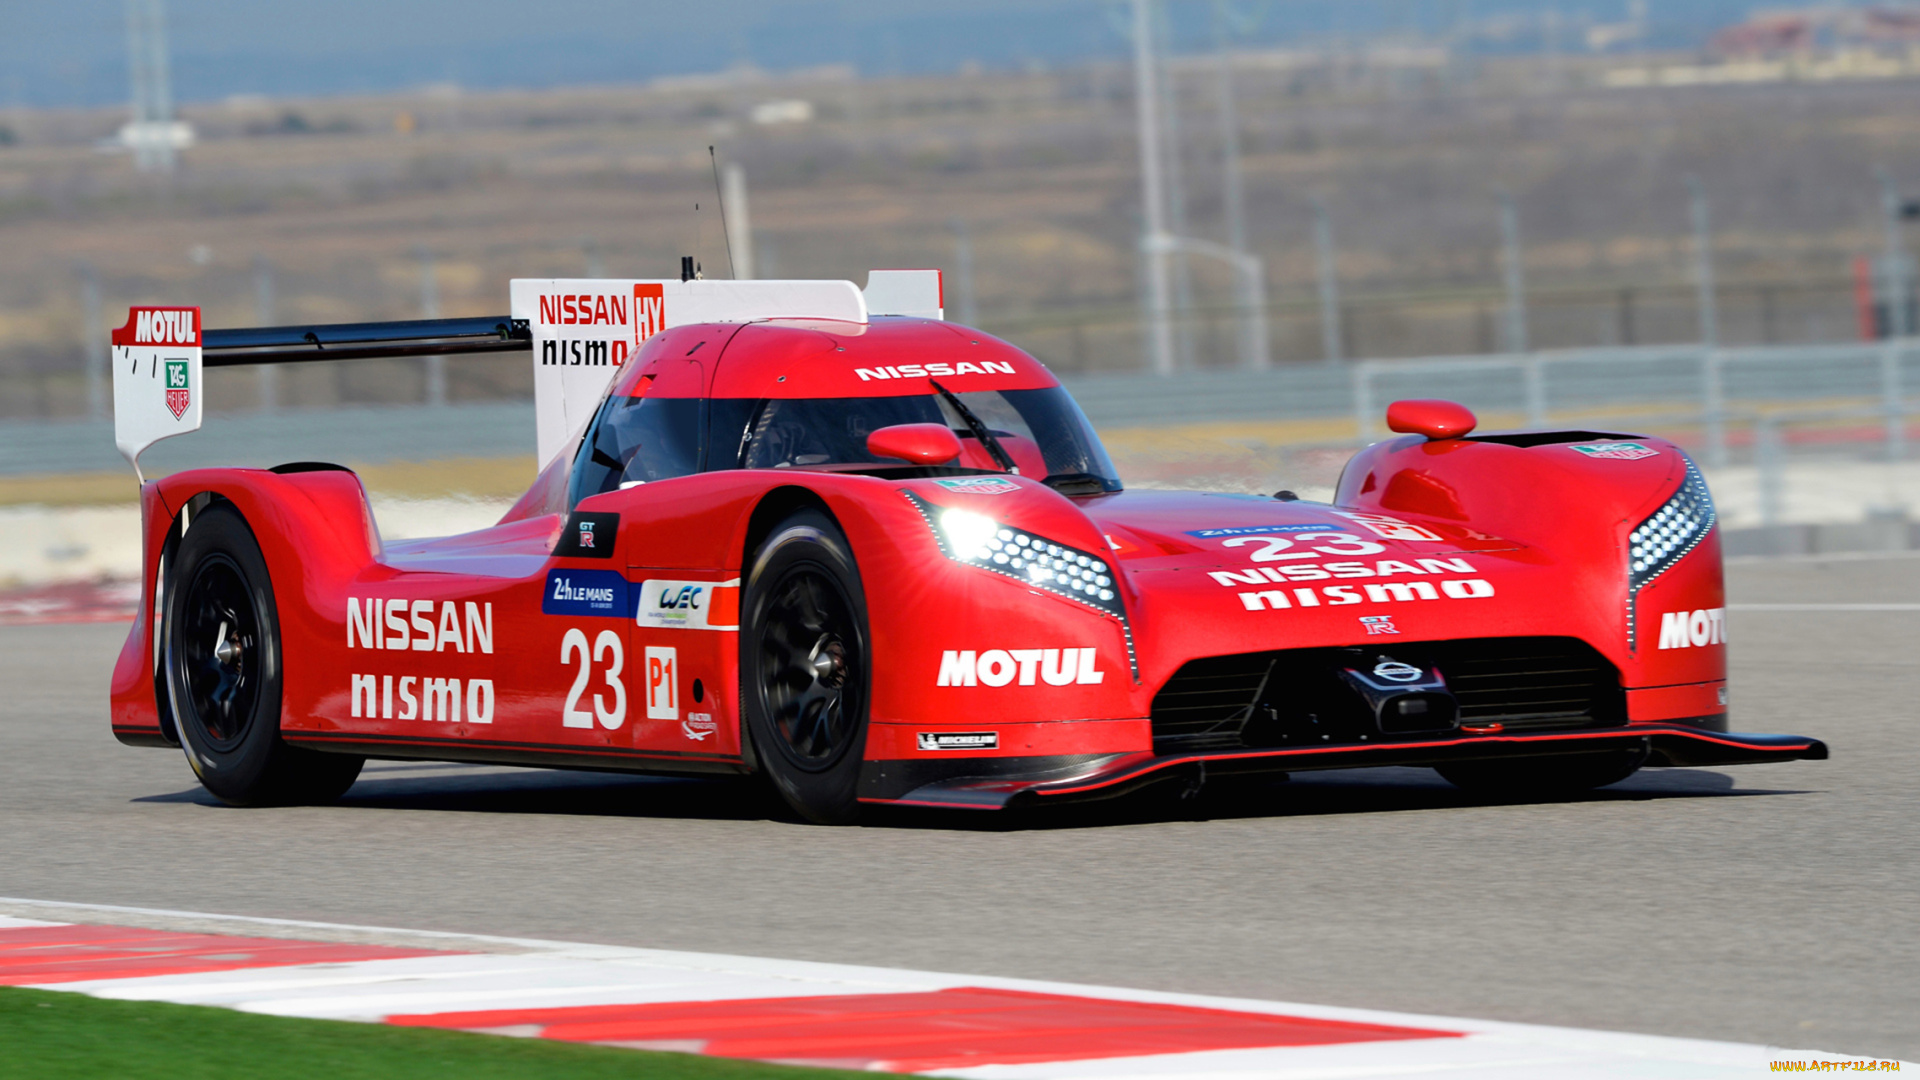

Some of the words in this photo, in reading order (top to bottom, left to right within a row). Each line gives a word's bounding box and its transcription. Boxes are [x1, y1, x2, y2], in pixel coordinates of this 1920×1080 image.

[539, 295, 627, 325] NISSAN
[635, 297, 662, 343] HY
[135, 311, 196, 343] MOTUL
[542, 340, 628, 366] nismo
[168, 364, 186, 387] TAG
[854, 361, 1016, 381] NISSAN
[167, 391, 189, 414] HEUER
[579, 522, 595, 531] GT
[579, 531, 595, 547] R
[1365, 523, 1434, 539] P1
[1221, 532, 1387, 563] 23
[1207, 558, 1477, 587] NISSAN
[573, 588, 585, 600] LE
[586, 588, 613, 601] MANS
[659, 585, 702, 609] WEC
[1238, 579, 1495, 611] nismo
[347, 597, 493, 654] NISSAN
[1359, 615, 1392, 623] GT
[1362, 622, 1401, 634] R
[560, 628, 627, 730] 23
[937, 647, 1105, 687] MOTUL
[649, 657, 674, 709] P1
[351, 673, 495, 724] nismo
[938, 735, 997, 744] MICHELIN
